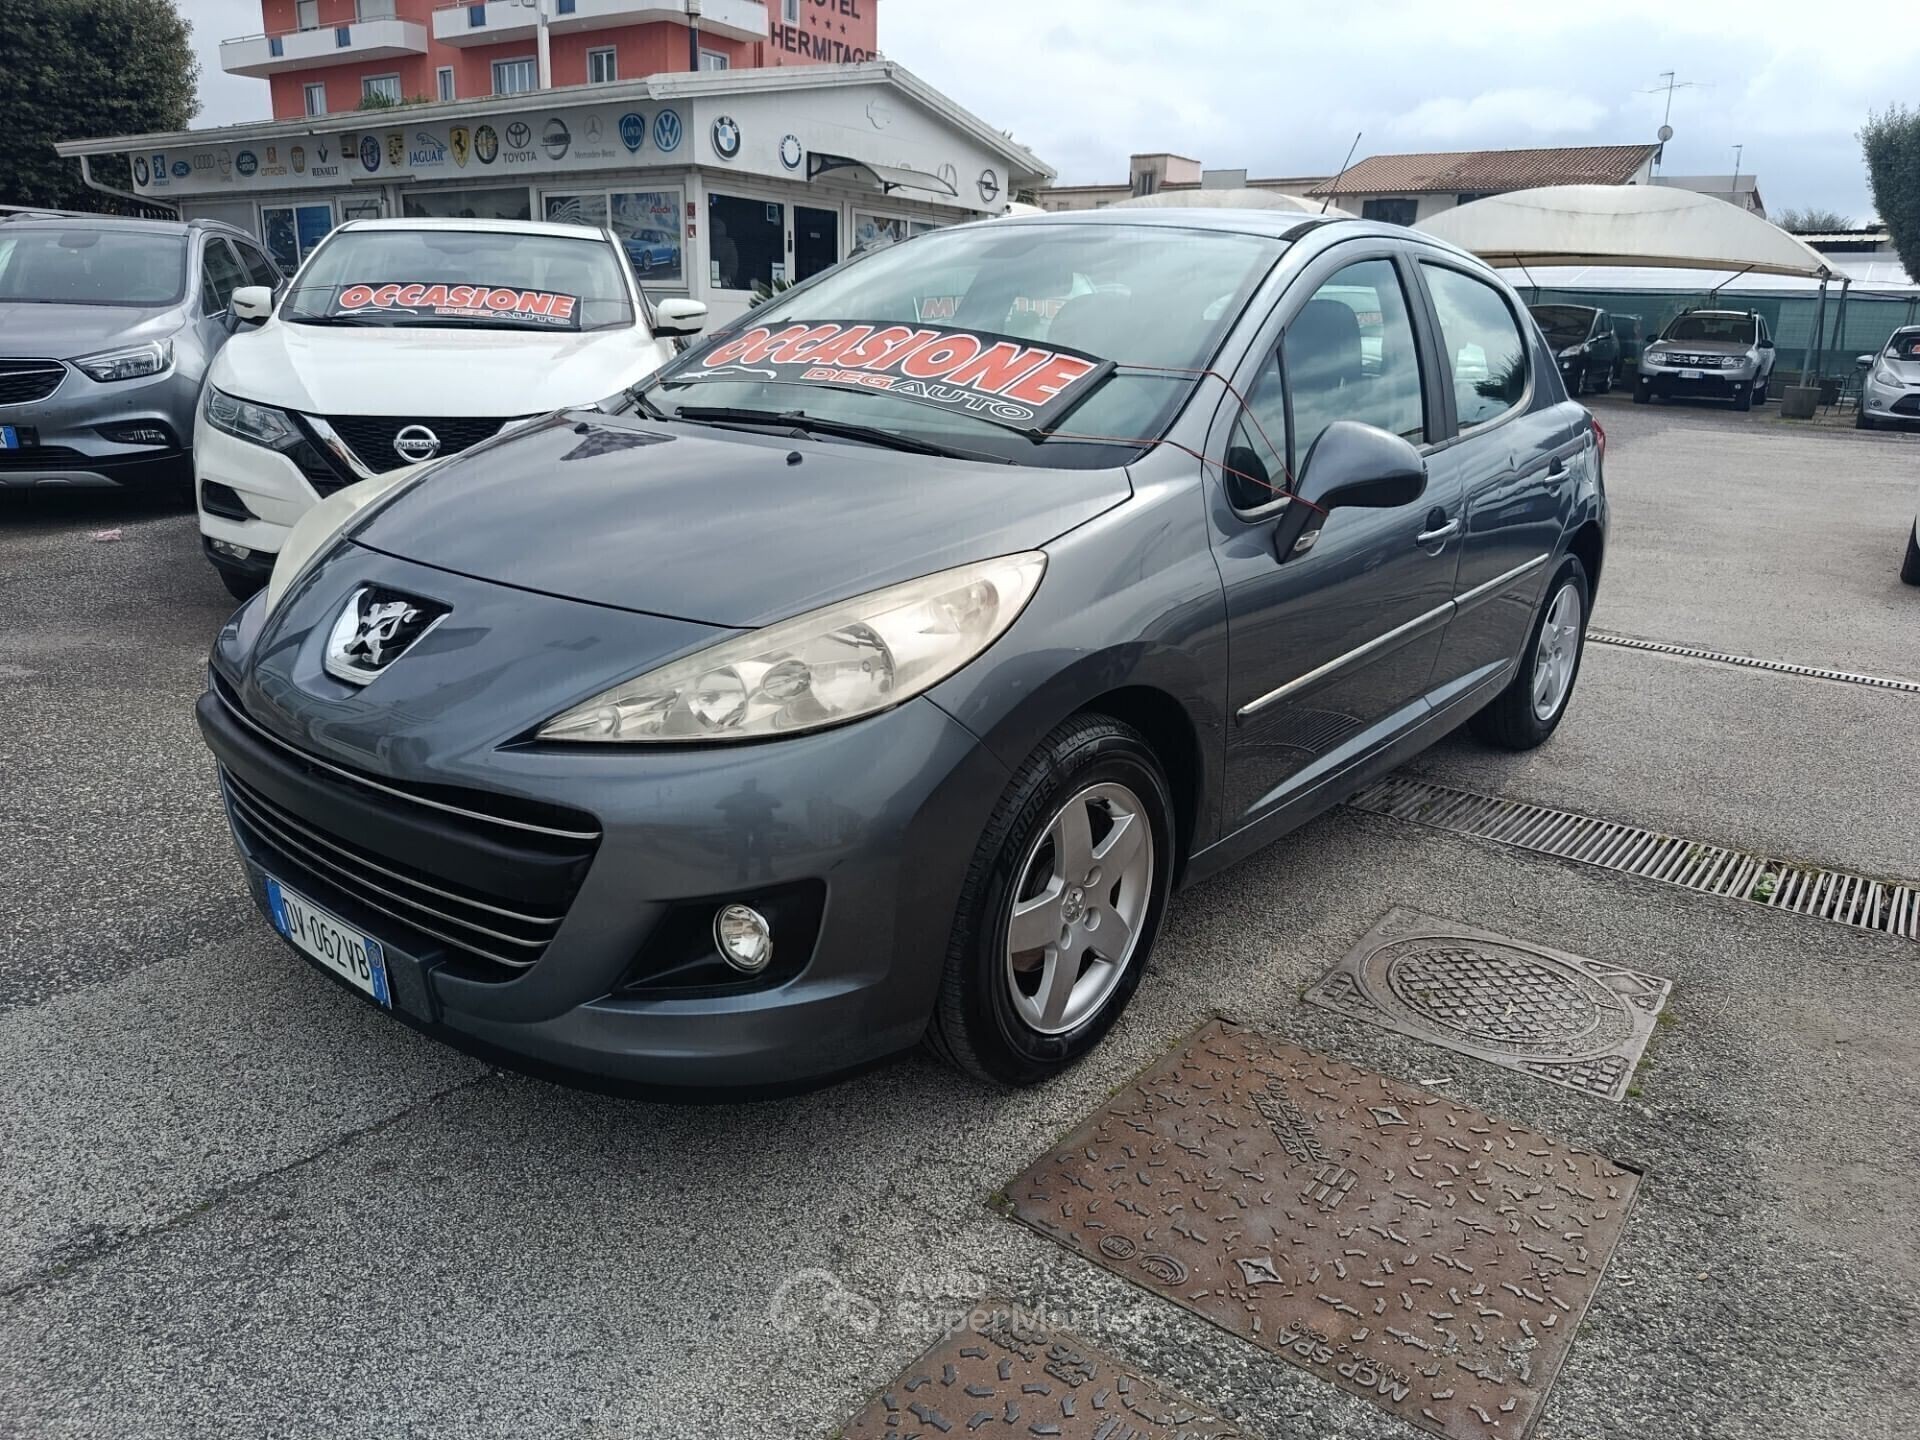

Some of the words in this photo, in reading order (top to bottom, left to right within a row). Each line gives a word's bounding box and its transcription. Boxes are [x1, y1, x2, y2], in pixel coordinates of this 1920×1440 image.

[312, 166, 339, 177] RENAULT
[409, 149, 444, 167] JAGUAR
[503, 151, 537, 164] TOYOTA
[650, 206, 671, 214] Audi
[339, 284, 577, 318] OCCASIONE
[702, 323, 1099, 406] OCCASIONE
[799, 366, 1034, 421] DEGAUTO
[1003, 745, 1094, 864] BRIDGESONE
[1046, 1342, 1099, 1381] SPA
[1278, 1327, 1334, 1364] SPA
[1337, 1361, 1410, 1403] MCP
